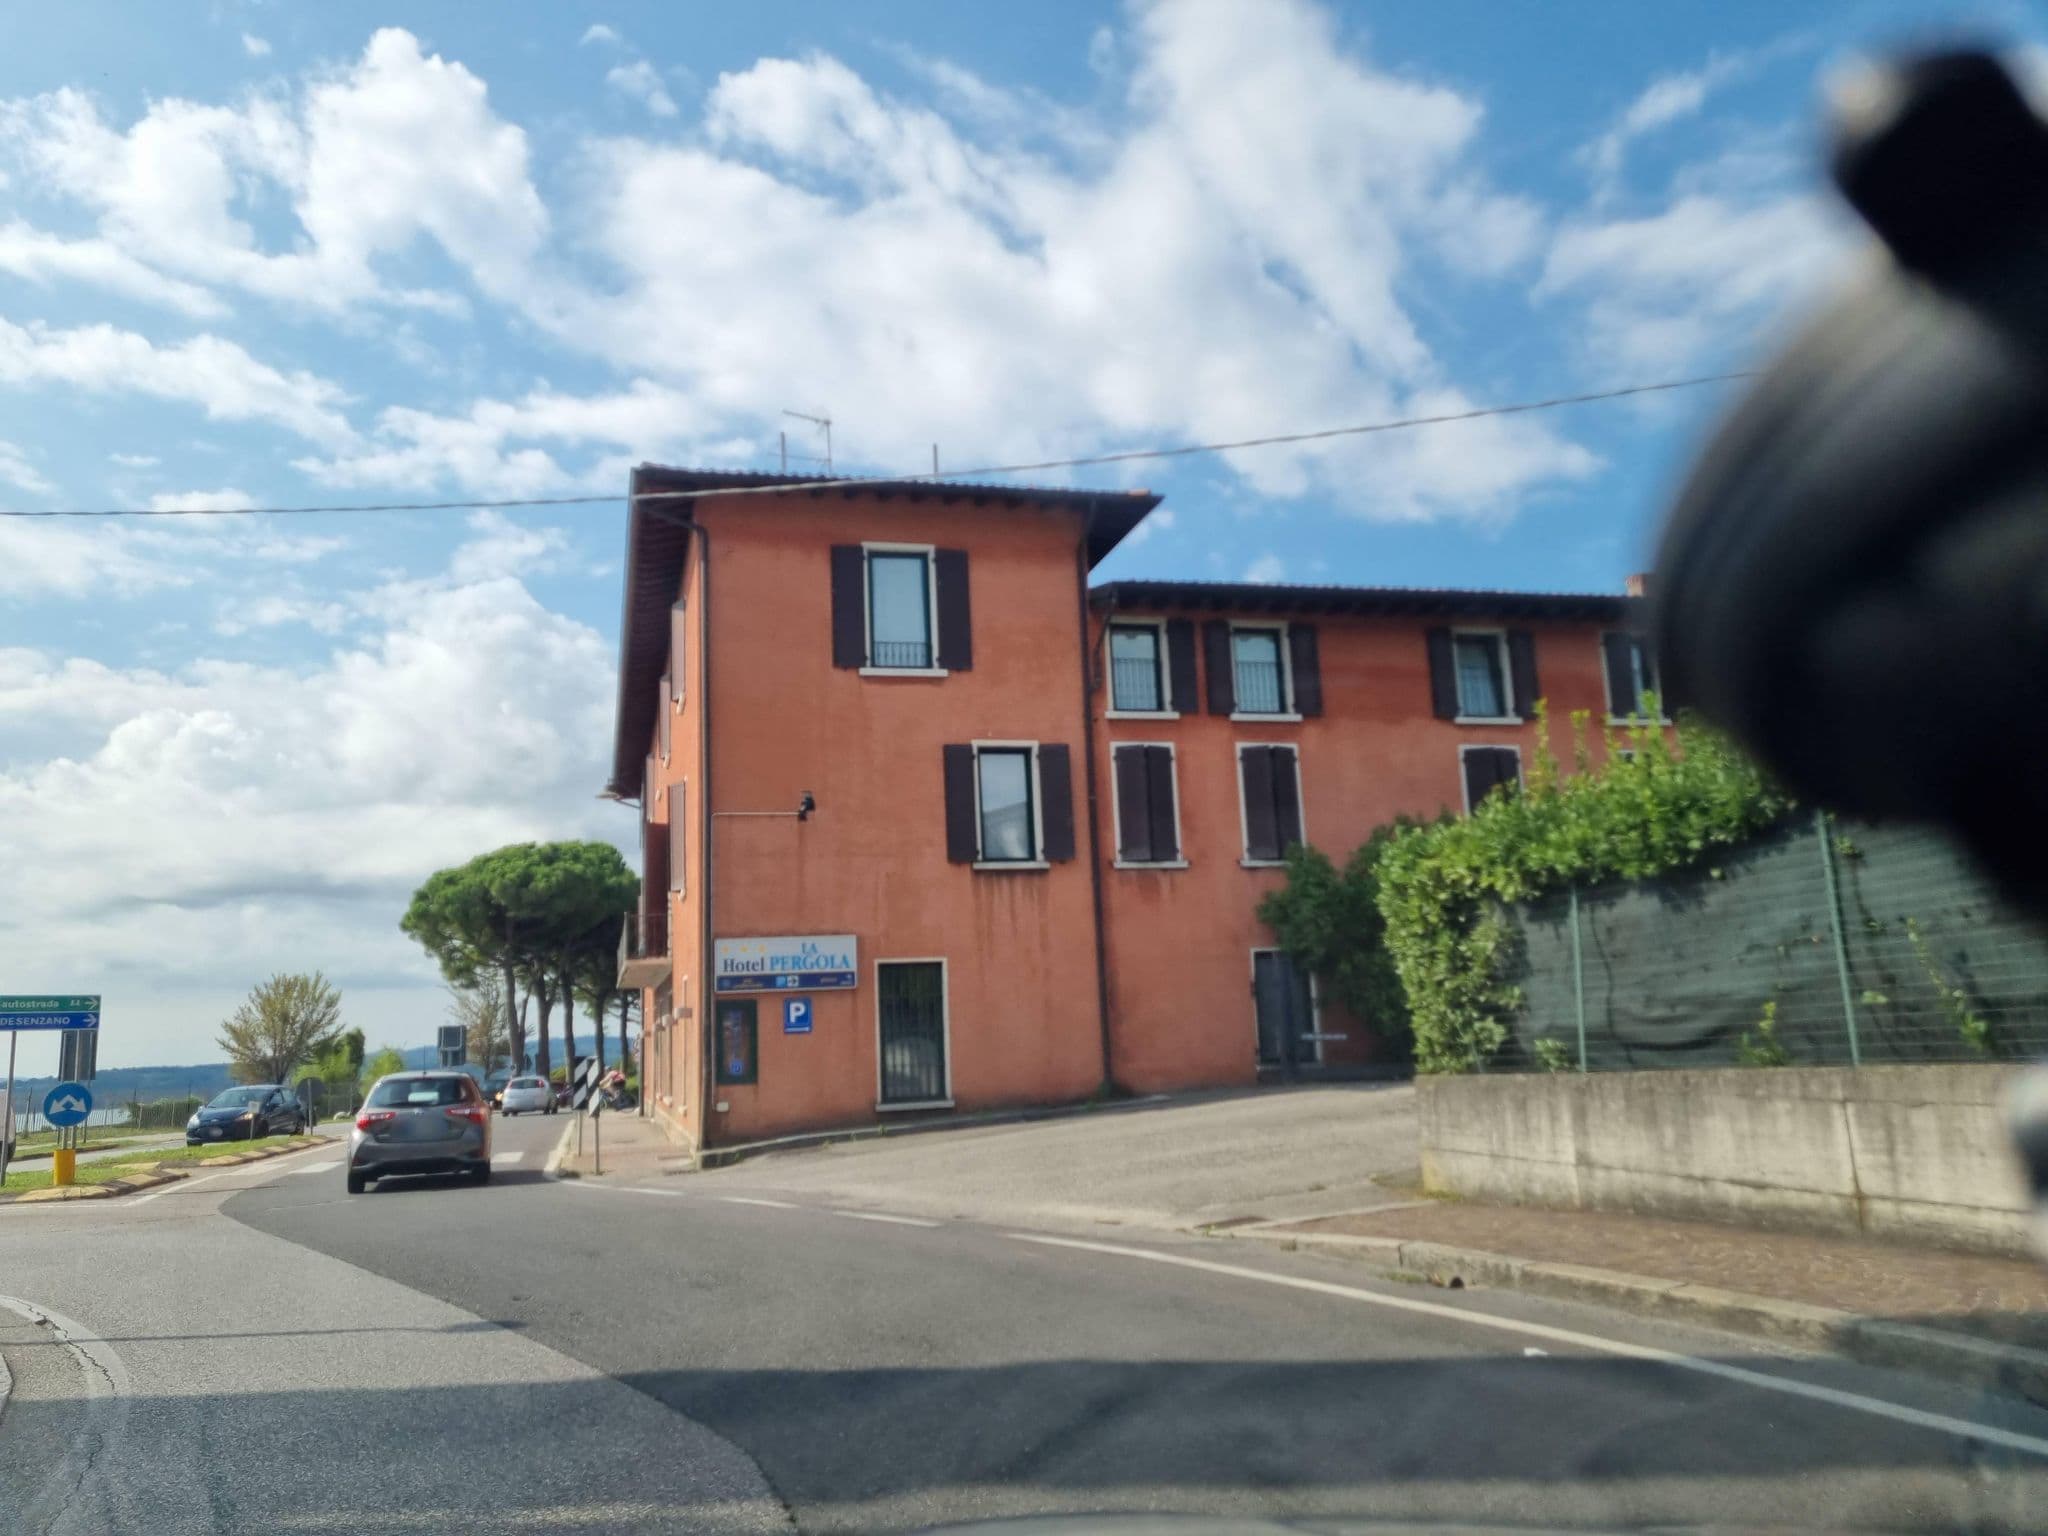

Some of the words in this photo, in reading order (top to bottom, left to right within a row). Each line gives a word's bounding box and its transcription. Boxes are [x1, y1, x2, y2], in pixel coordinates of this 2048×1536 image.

[802, 942, 818, 955] LA
[723, 957, 765, 972] Hotel
[769, 954, 850, 971] PERGOLA
[1, 999, 59, 1009] autostrada
[789, 1002, 806, 1023] P
[0, 1016, 71, 1026] DESENZANO
